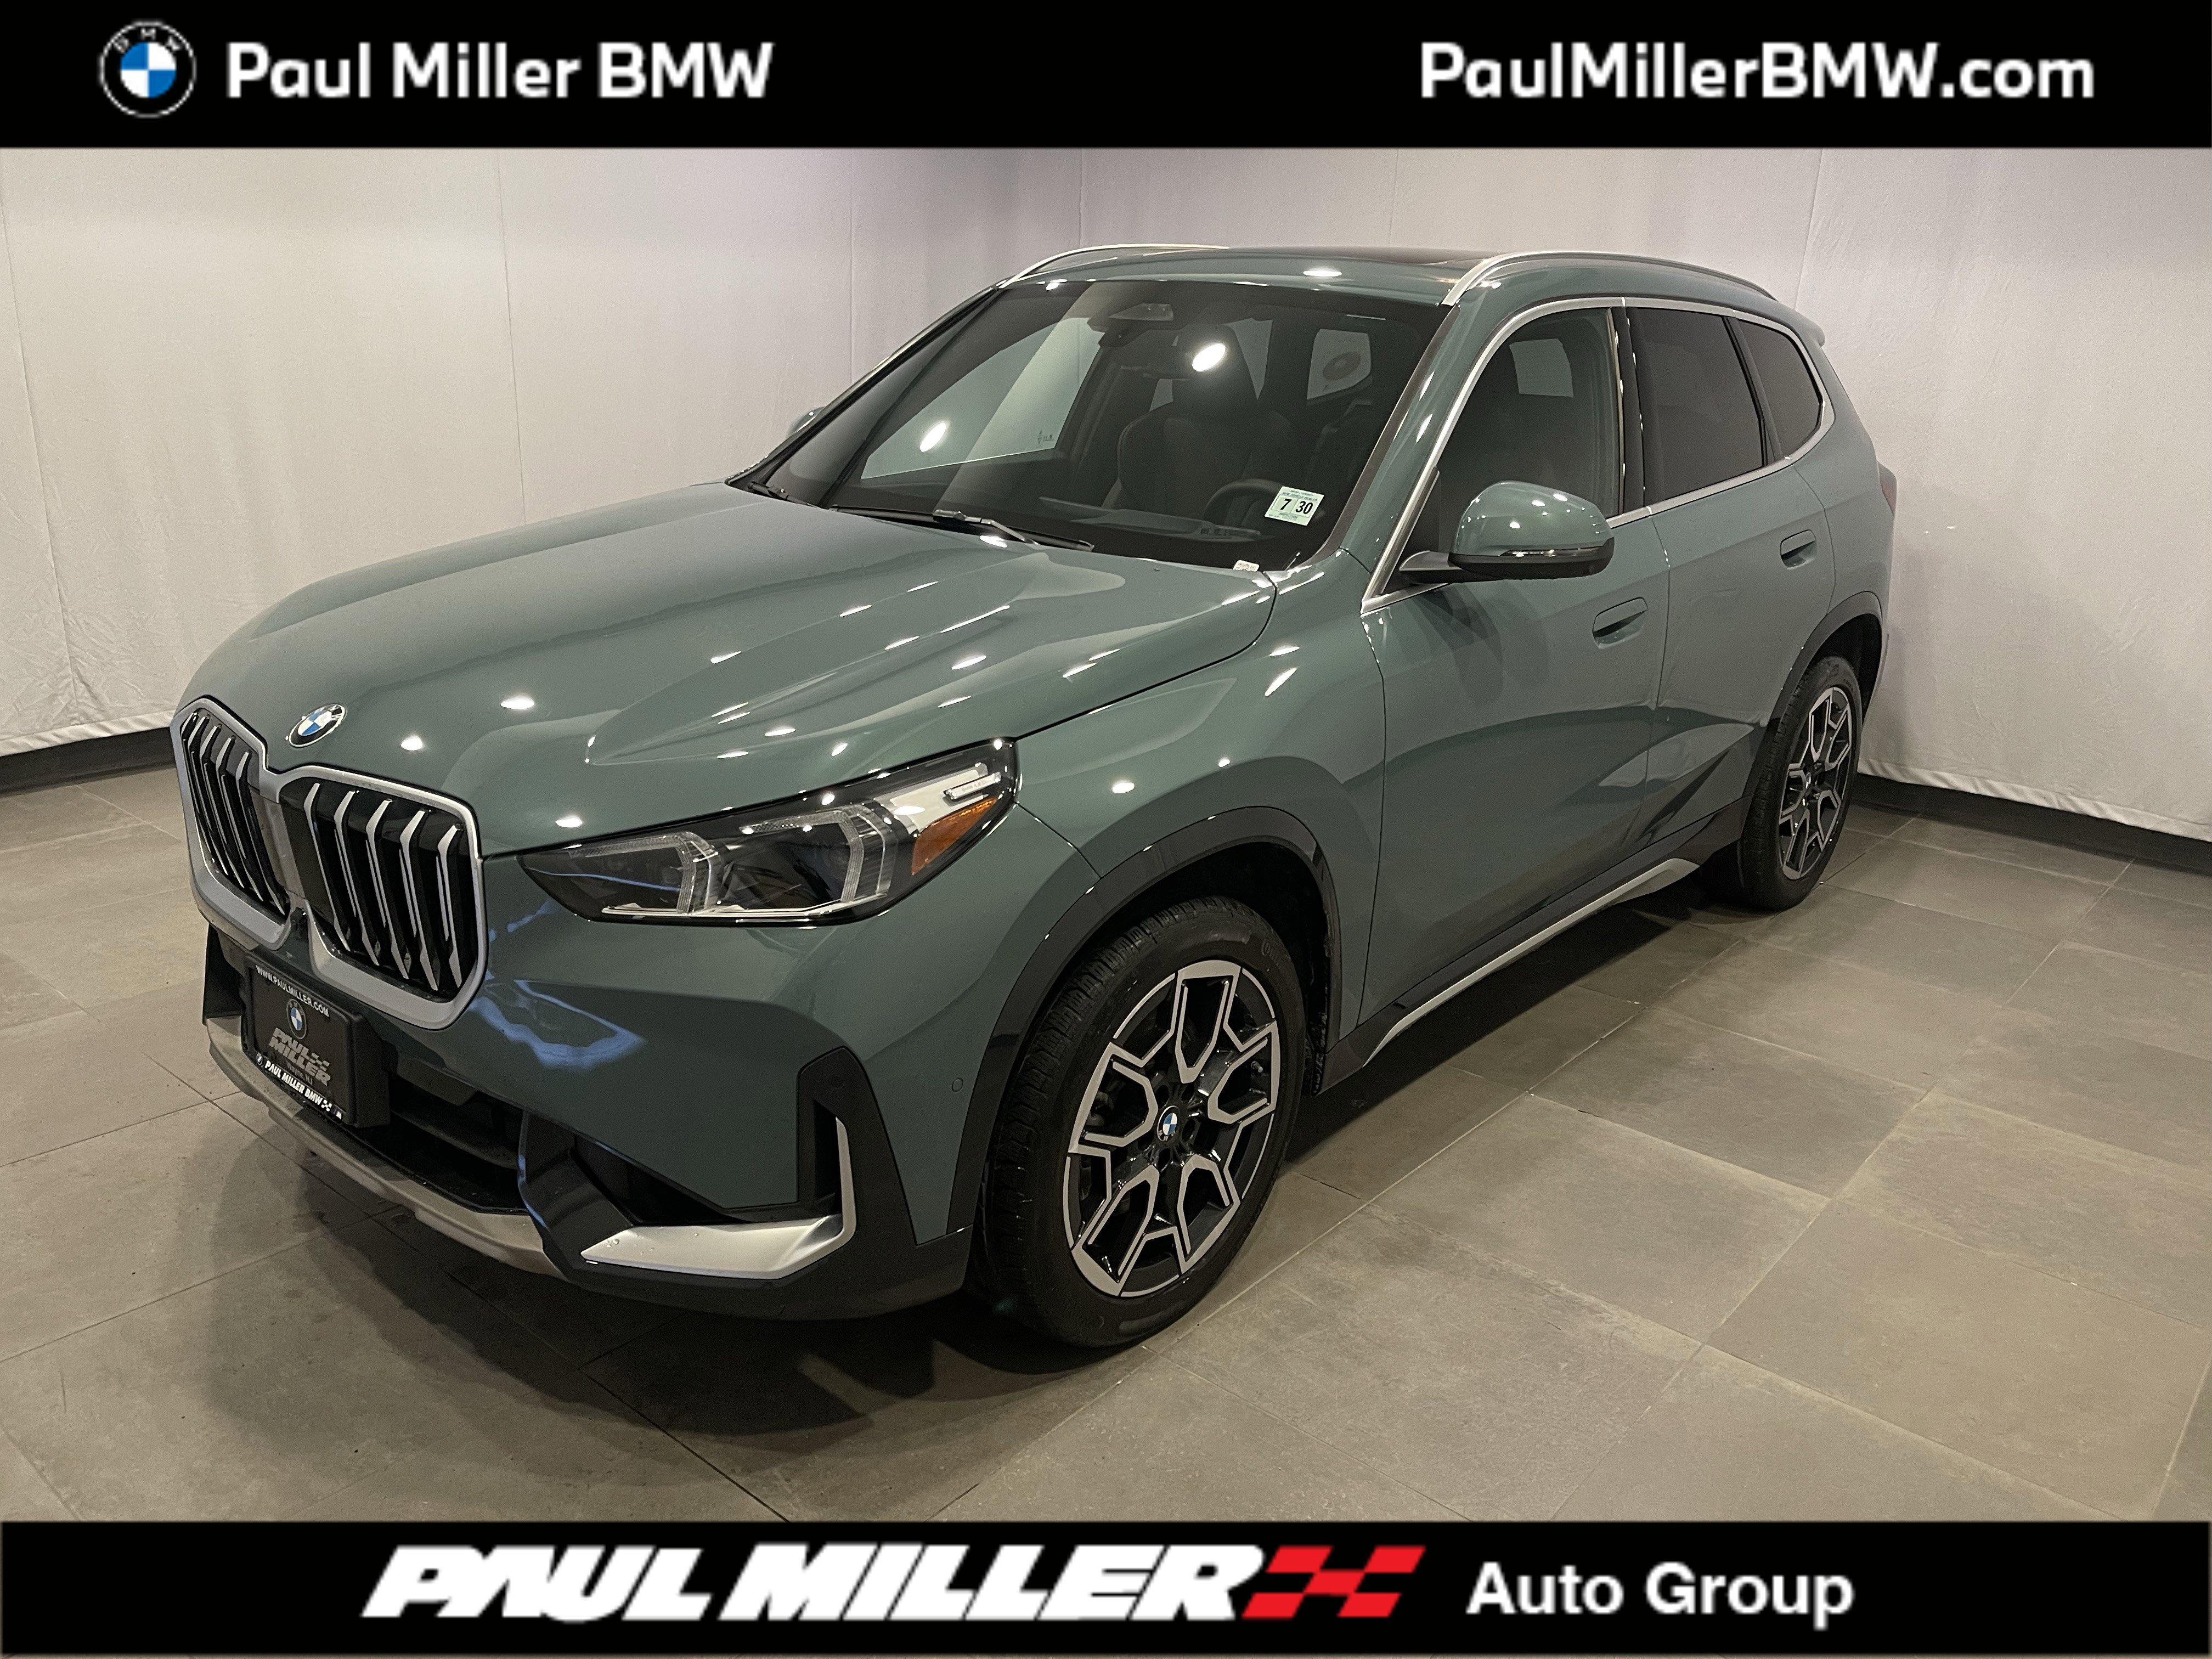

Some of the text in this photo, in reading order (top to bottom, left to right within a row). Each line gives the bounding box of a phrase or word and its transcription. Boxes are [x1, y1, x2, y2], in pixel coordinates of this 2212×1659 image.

[1280, 498, 1313, 515] 7 30
[256, 964, 330, 1018] WWW.PAULMILLER.COM
[269, 1036, 331, 1086] MILLER
[273, 1027, 309, 1060] PAUL
[264, 1060, 282, 1079] PAUL
[281, 1072, 305, 1094] MILLER
[304, 1088, 323, 1105] BMW
